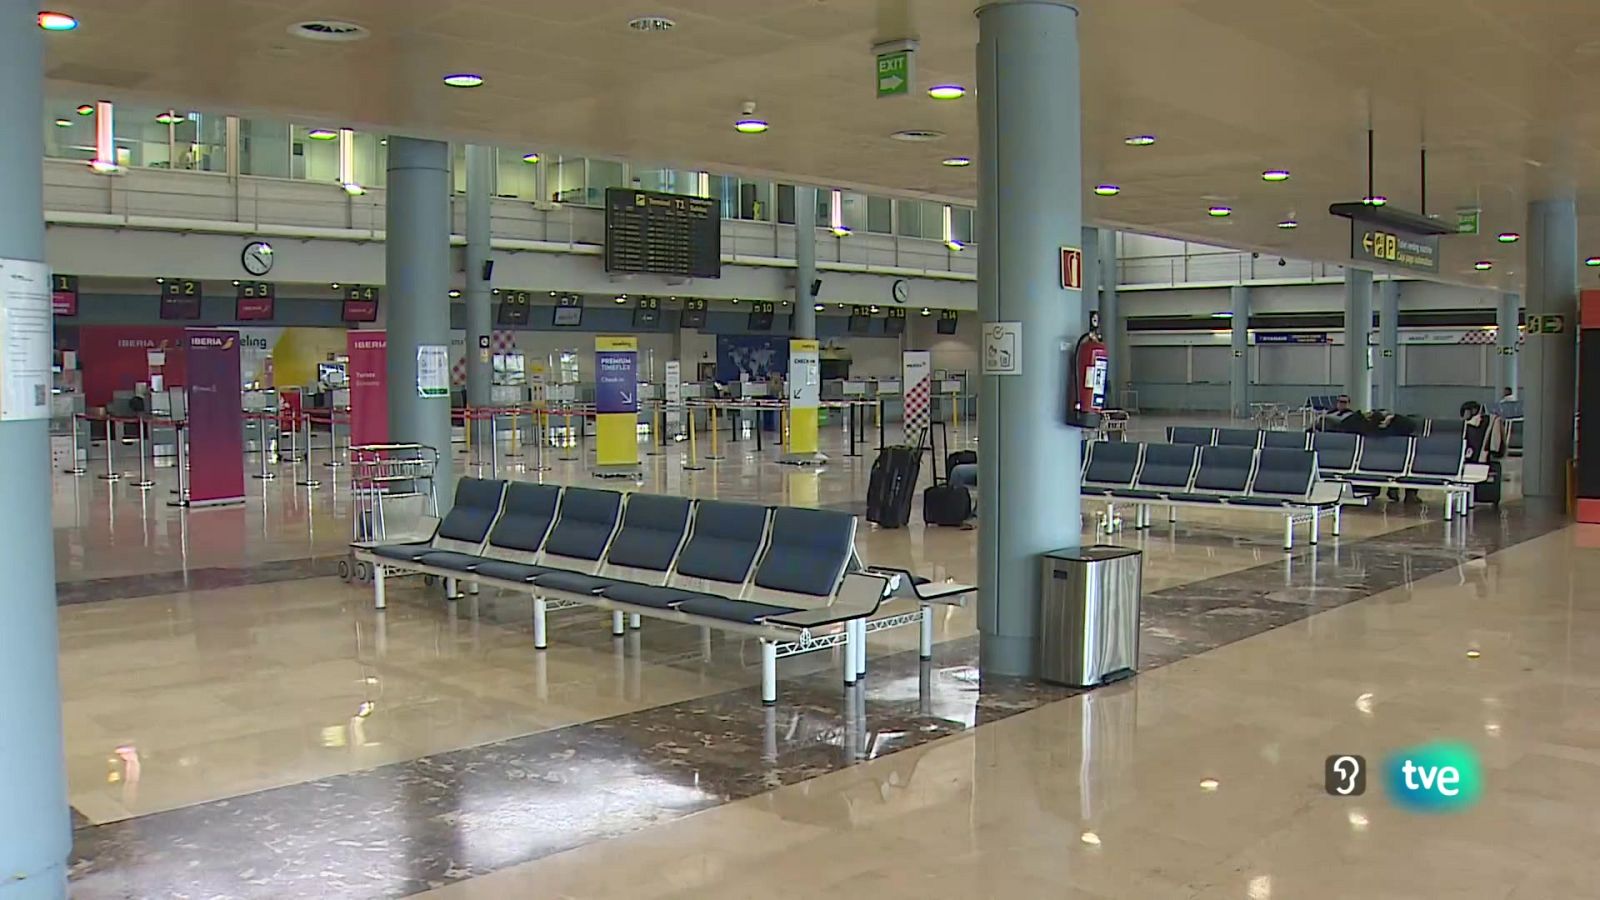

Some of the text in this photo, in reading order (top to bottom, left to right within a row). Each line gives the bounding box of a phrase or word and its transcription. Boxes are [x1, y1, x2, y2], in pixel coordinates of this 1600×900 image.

[880, 57, 904, 72] EXIT
[675, 199, 685, 209] T1
[60, 277, 69, 289] 1
[185, 282, 194, 294] 2
[259, 284, 268, 296] 3
[364, 288, 373, 300] 4
[518, 293, 525, 304] 6
[571, 295, 579, 305] 7
[649, 299, 656, 308] 8
[697, 300, 704, 309] 9
[762, 303, 773, 313] 10
[117, 339, 155, 348] IBERIA
[191, 337, 222, 346] IBERIA
